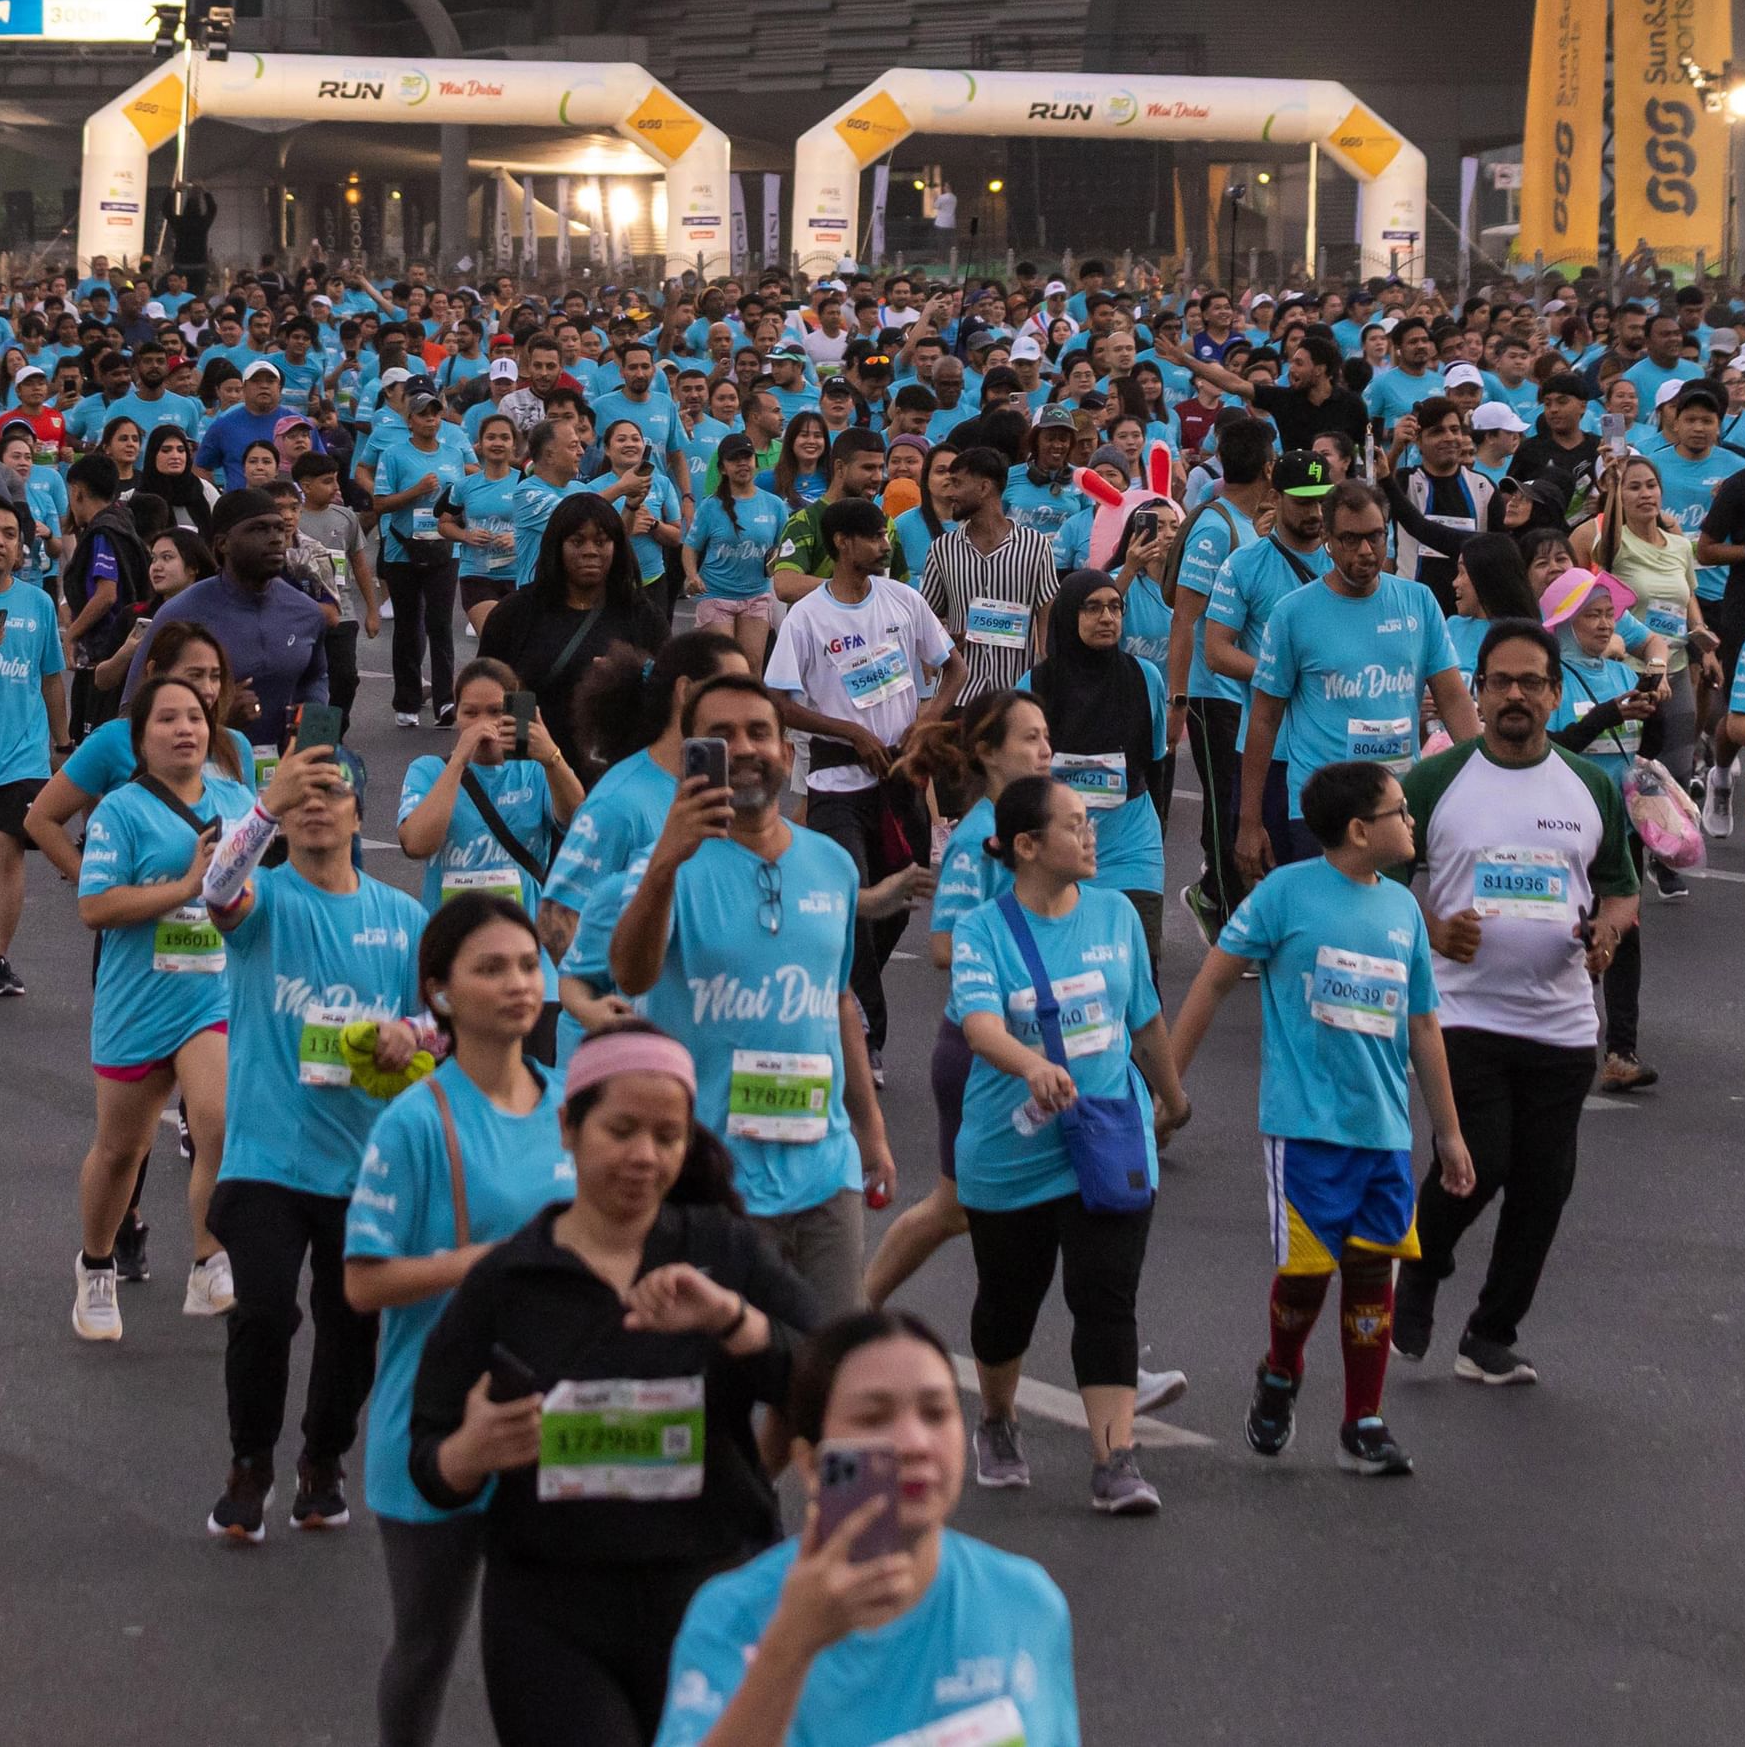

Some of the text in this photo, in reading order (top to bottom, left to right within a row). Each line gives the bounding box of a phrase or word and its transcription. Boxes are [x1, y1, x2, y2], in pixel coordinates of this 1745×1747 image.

[318, 80, 505, 100] RUN Mai Dubai
[1028, 102, 1210, 122] RUN Mai Dubai
[974, 616, 1012, 630] 756990
[1377, 624, 1403, 634] RUN
[1322, 674, 1362, 700] Mai
[1354, 743, 1400, 755] 804422
[1060, 773, 1104, 787] 04421
[1495, 853, 1517, 862] RUN
[1483, 874, 1544, 892] 811936
[163, 933, 221, 948] 156011
[1336, 957, 1357, 968] RUN
[688, 963, 840, 1025] Mai Dub
[1321, 979, 1381, 1002] 700639
[321, 1013, 346, 1023] RUN
[1019, 1008, 1083, 1037] 7040
[309, 1036, 340, 1052] 135
[742, 1086, 807, 1107] 178771
